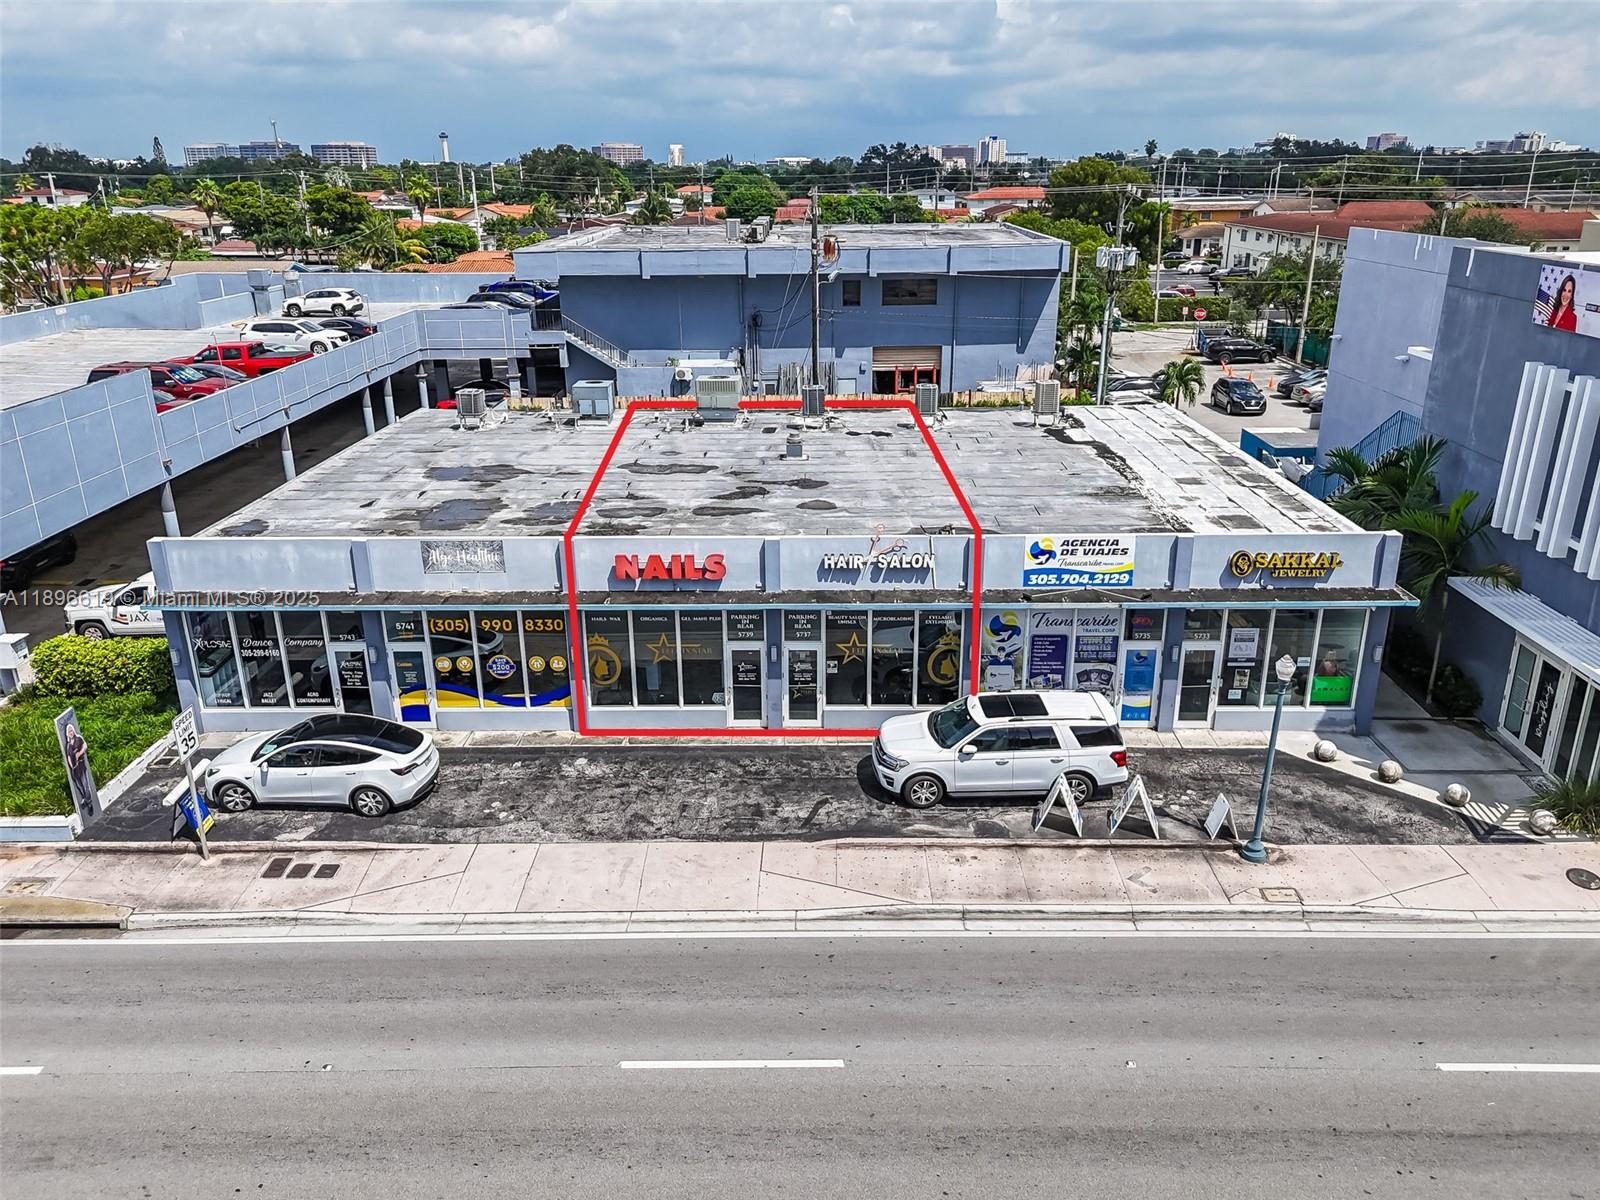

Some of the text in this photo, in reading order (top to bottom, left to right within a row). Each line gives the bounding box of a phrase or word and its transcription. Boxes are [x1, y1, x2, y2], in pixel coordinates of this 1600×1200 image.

[1060, 539, 1120, 547] AGENCIA
[1060, 548, 1130, 556] DE VIAJES
[823, 554, 937, 570] HAIR SALON
[1057, 558, 1102, 567] Transcaribe
[1255, 552, 1343, 568] SAKKAL
[615, 554, 727, 581] NAILS
[1272, 569, 1327, 577] JEWELRY
[1028, 573, 1130, 585] 305.704.2129
[129, 611, 150, 622] JAX
[1032, 611, 1119, 629] Transcaribe
[395, 622, 415, 630] 5741
[430, 618, 564, 633] (305) 990 8330
[242, 638, 273, 648] Dance
[283, 638, 325, 649] Company
[174, 711, 193, 730] SPEED
[178, 722, 193, 738] LIMIT
[181, 731, 196, 756] 35
